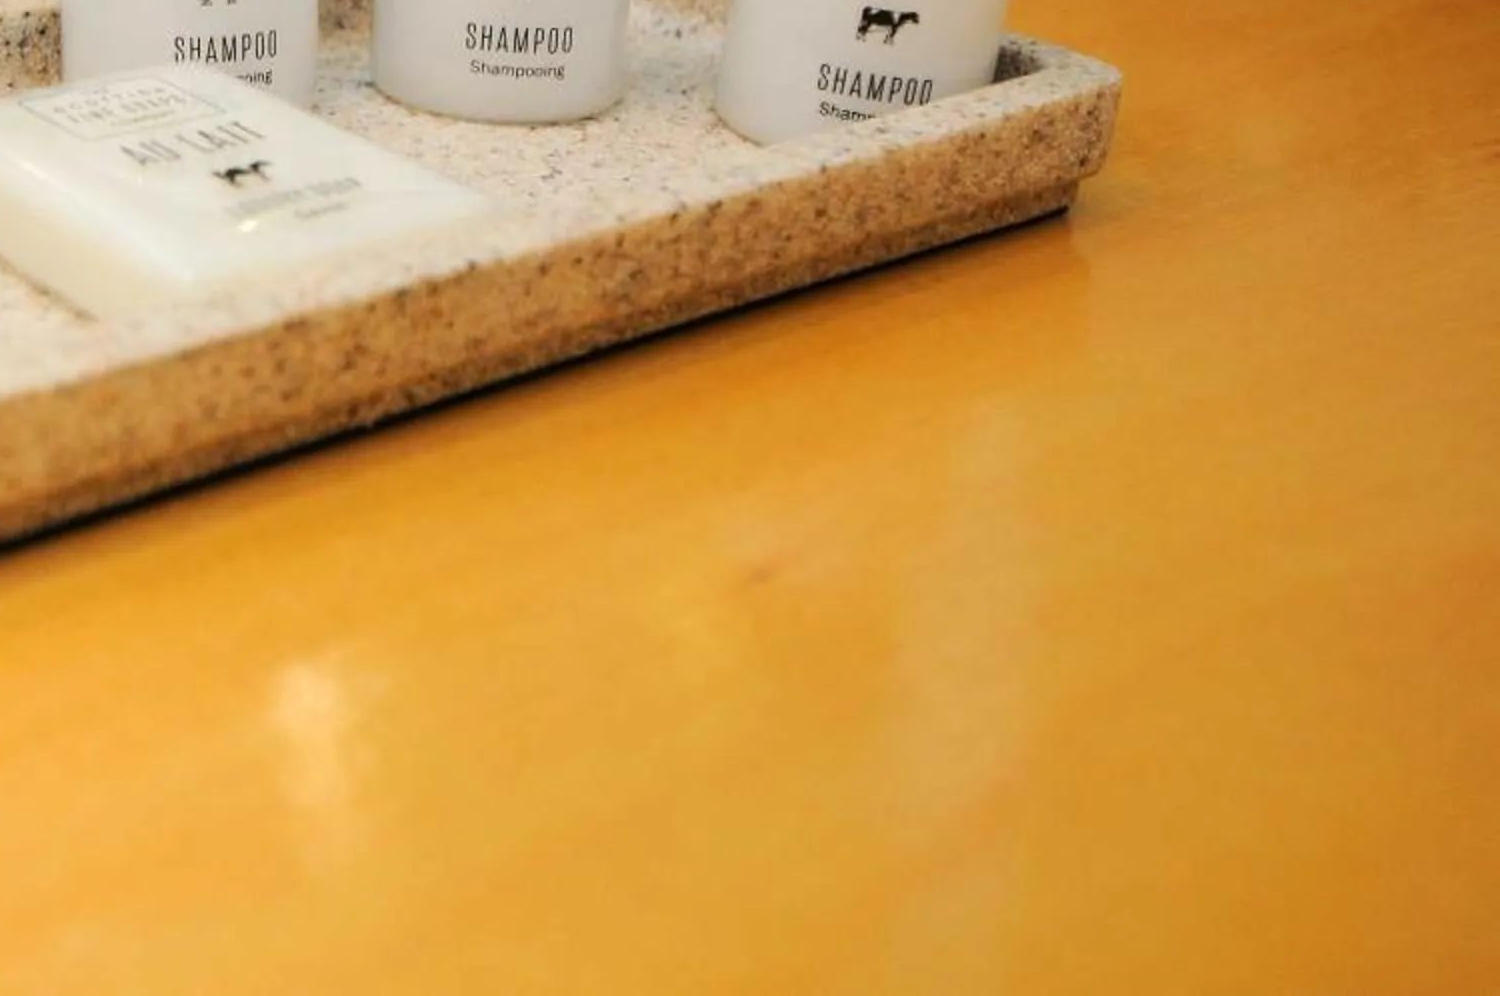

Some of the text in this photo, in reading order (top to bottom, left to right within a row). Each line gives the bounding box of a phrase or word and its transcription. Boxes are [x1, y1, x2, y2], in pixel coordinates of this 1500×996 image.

[174, 30, 277, 64] SHAMPOO
[466, 22, 573, 55] SHAMPOO
[470, 59, 565, 81] Shampooing
[817, 63, 933, 106] SHAMPOO
[175, 120, 267, 154] LAIT
